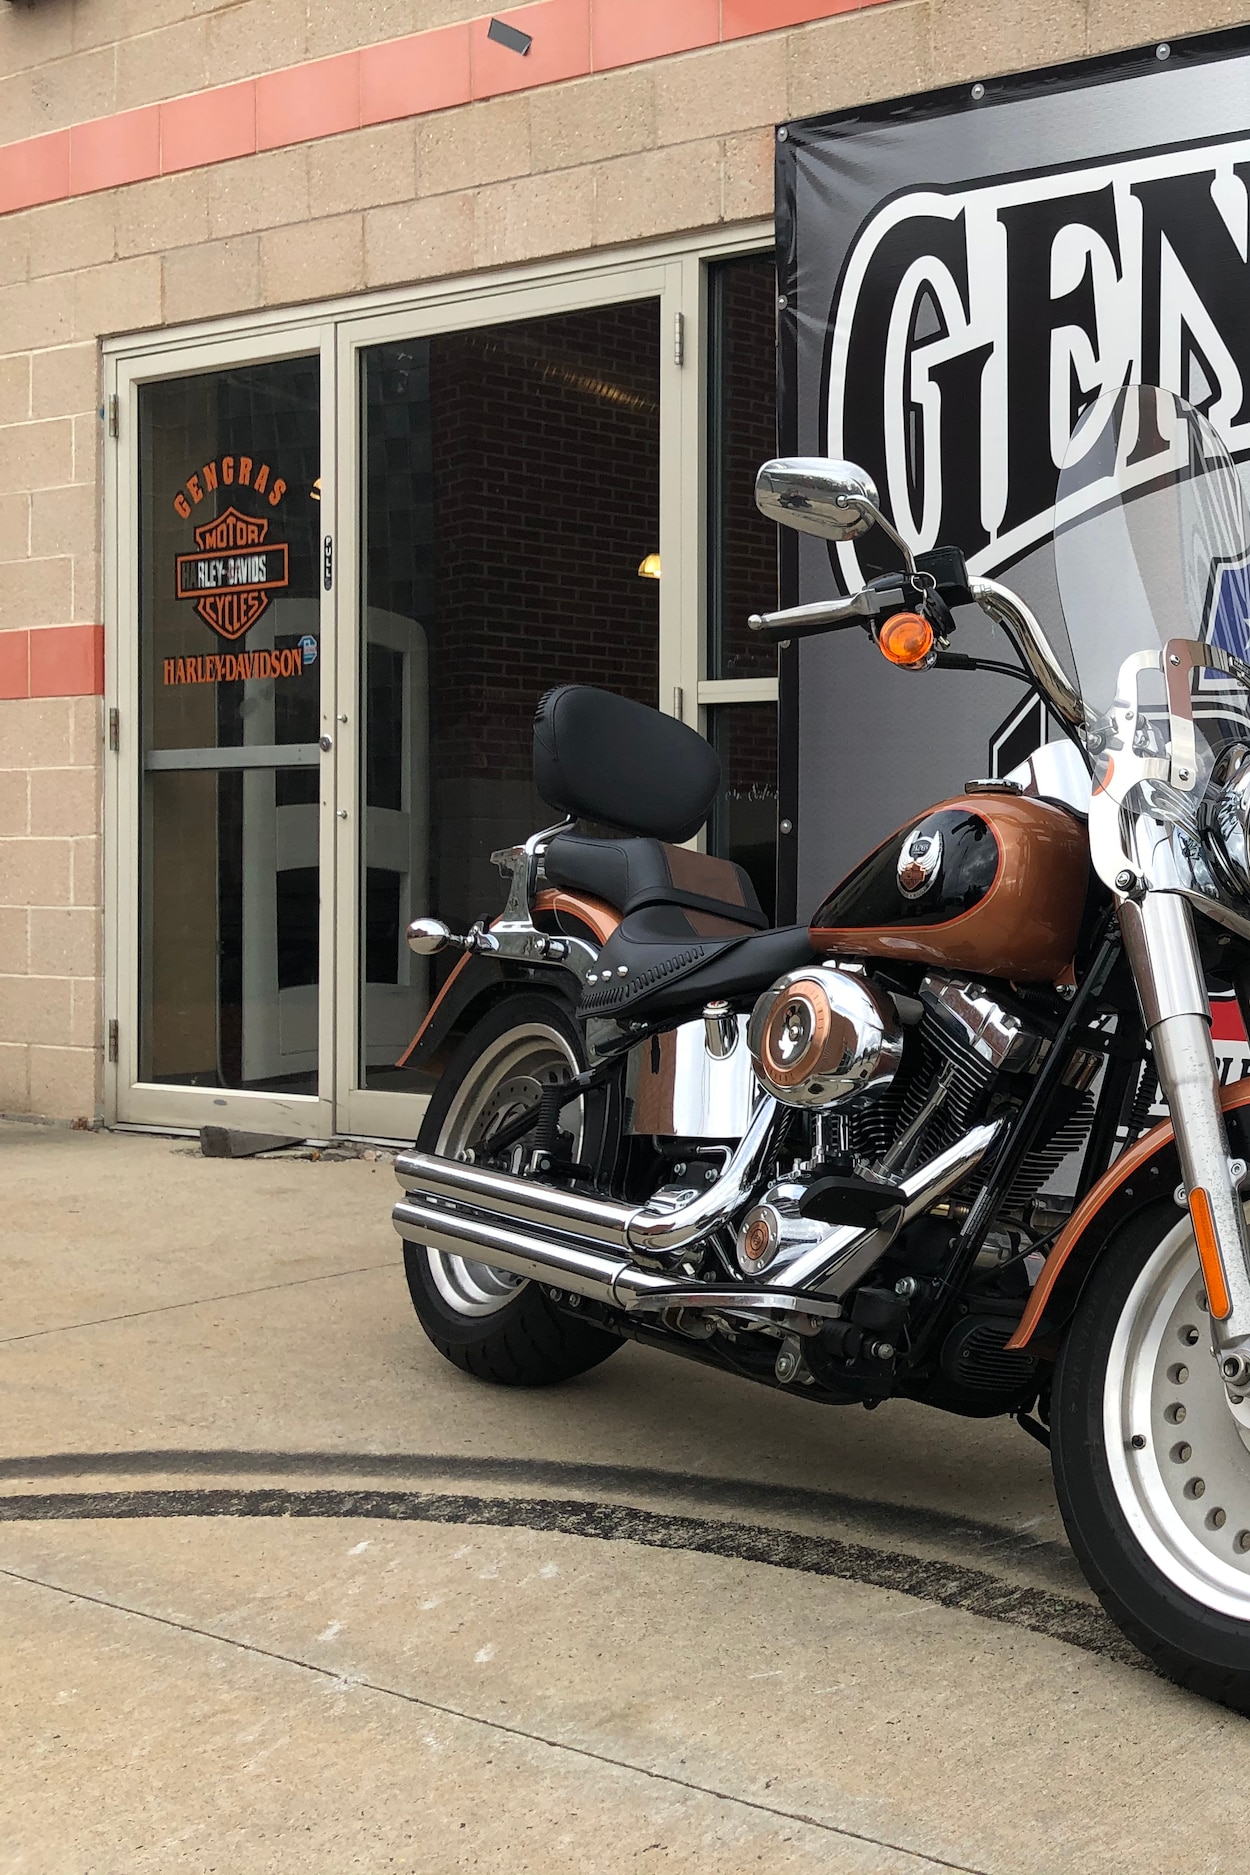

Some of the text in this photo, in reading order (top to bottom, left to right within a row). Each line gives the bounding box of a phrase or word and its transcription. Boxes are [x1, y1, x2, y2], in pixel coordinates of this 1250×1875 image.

[174, 455, 287, 519] GENGRAS
[205, 516, 259, 550] MOTOR
[181, 554, 271, 590] HARLEY-DAVIDS
[205, 592, 259, 632] CYCLES
[163, 648, 303, 686] HARLEY-DAVIDSON
